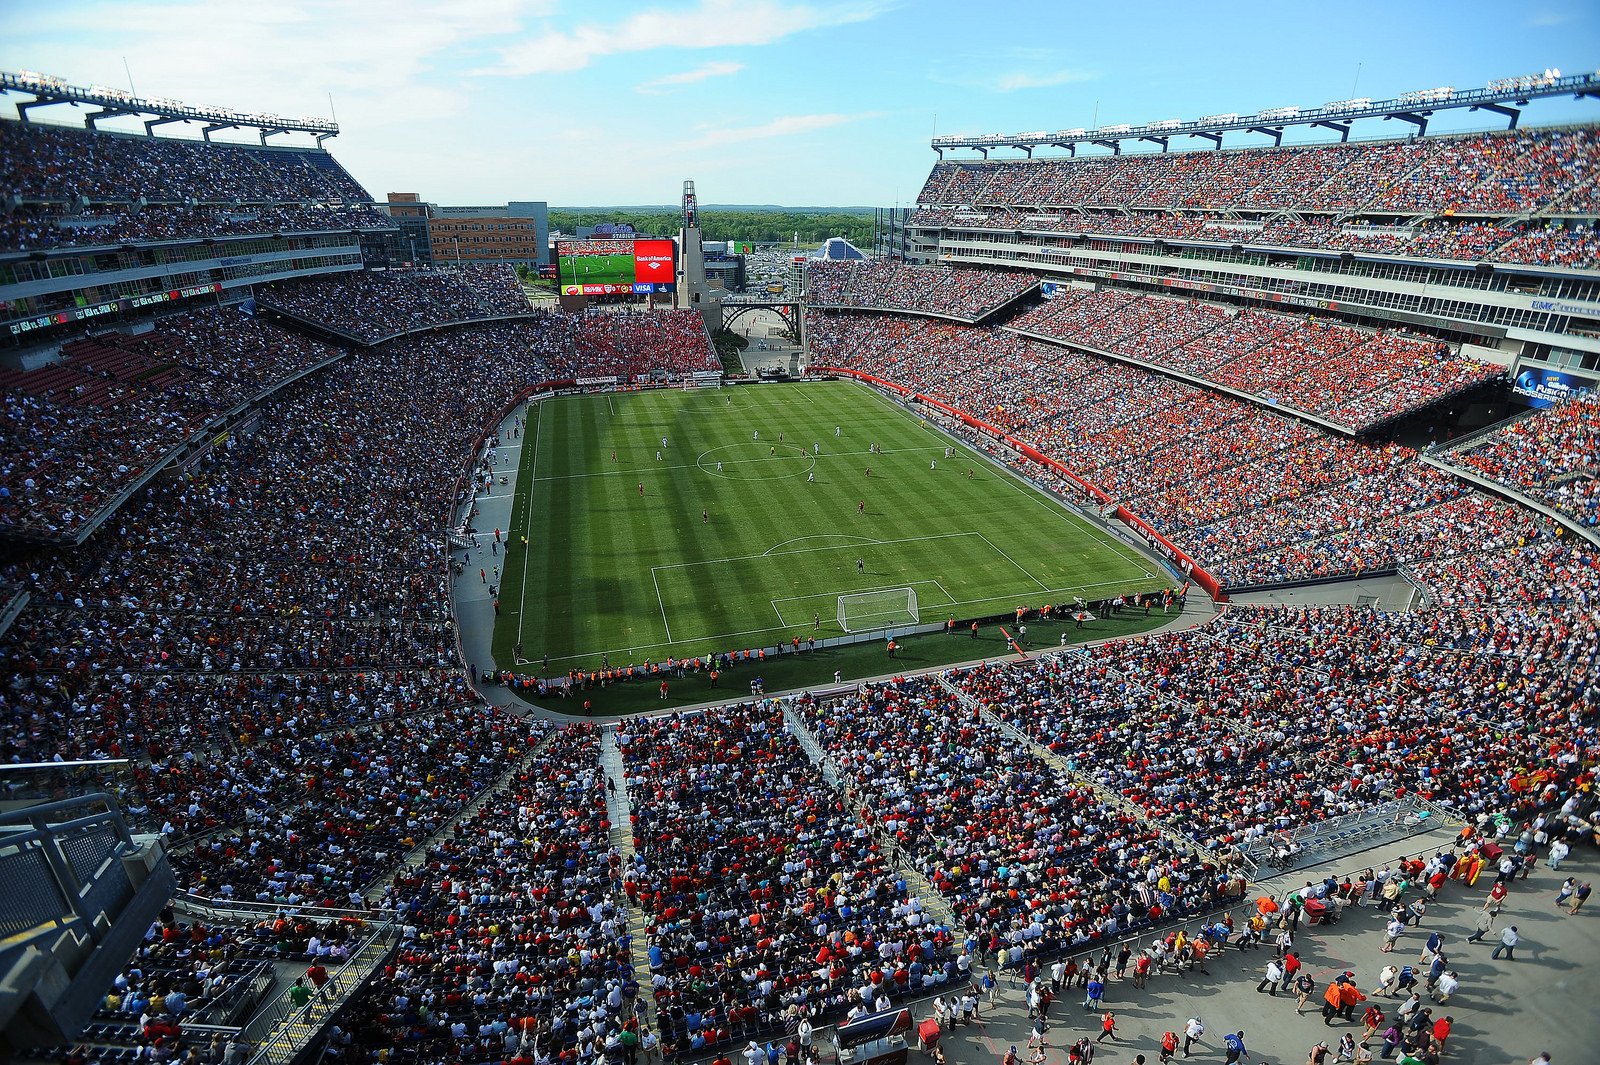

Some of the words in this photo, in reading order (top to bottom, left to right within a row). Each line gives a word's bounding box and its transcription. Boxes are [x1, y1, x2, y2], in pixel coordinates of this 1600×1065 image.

[1289, 296, 1298, 304] USA
[1304, 298, 1318, 307] SPAIN
[19, 320, 31, 331] USA
[37, 317, 51, 327] SPAIN
[1536, 384, 1567, 398] Fusion
[1547, 382, 1570, 391] Gillette
[1129, 519, 1139, 529] WE
[1138, 525, 1149, 537] ARE
